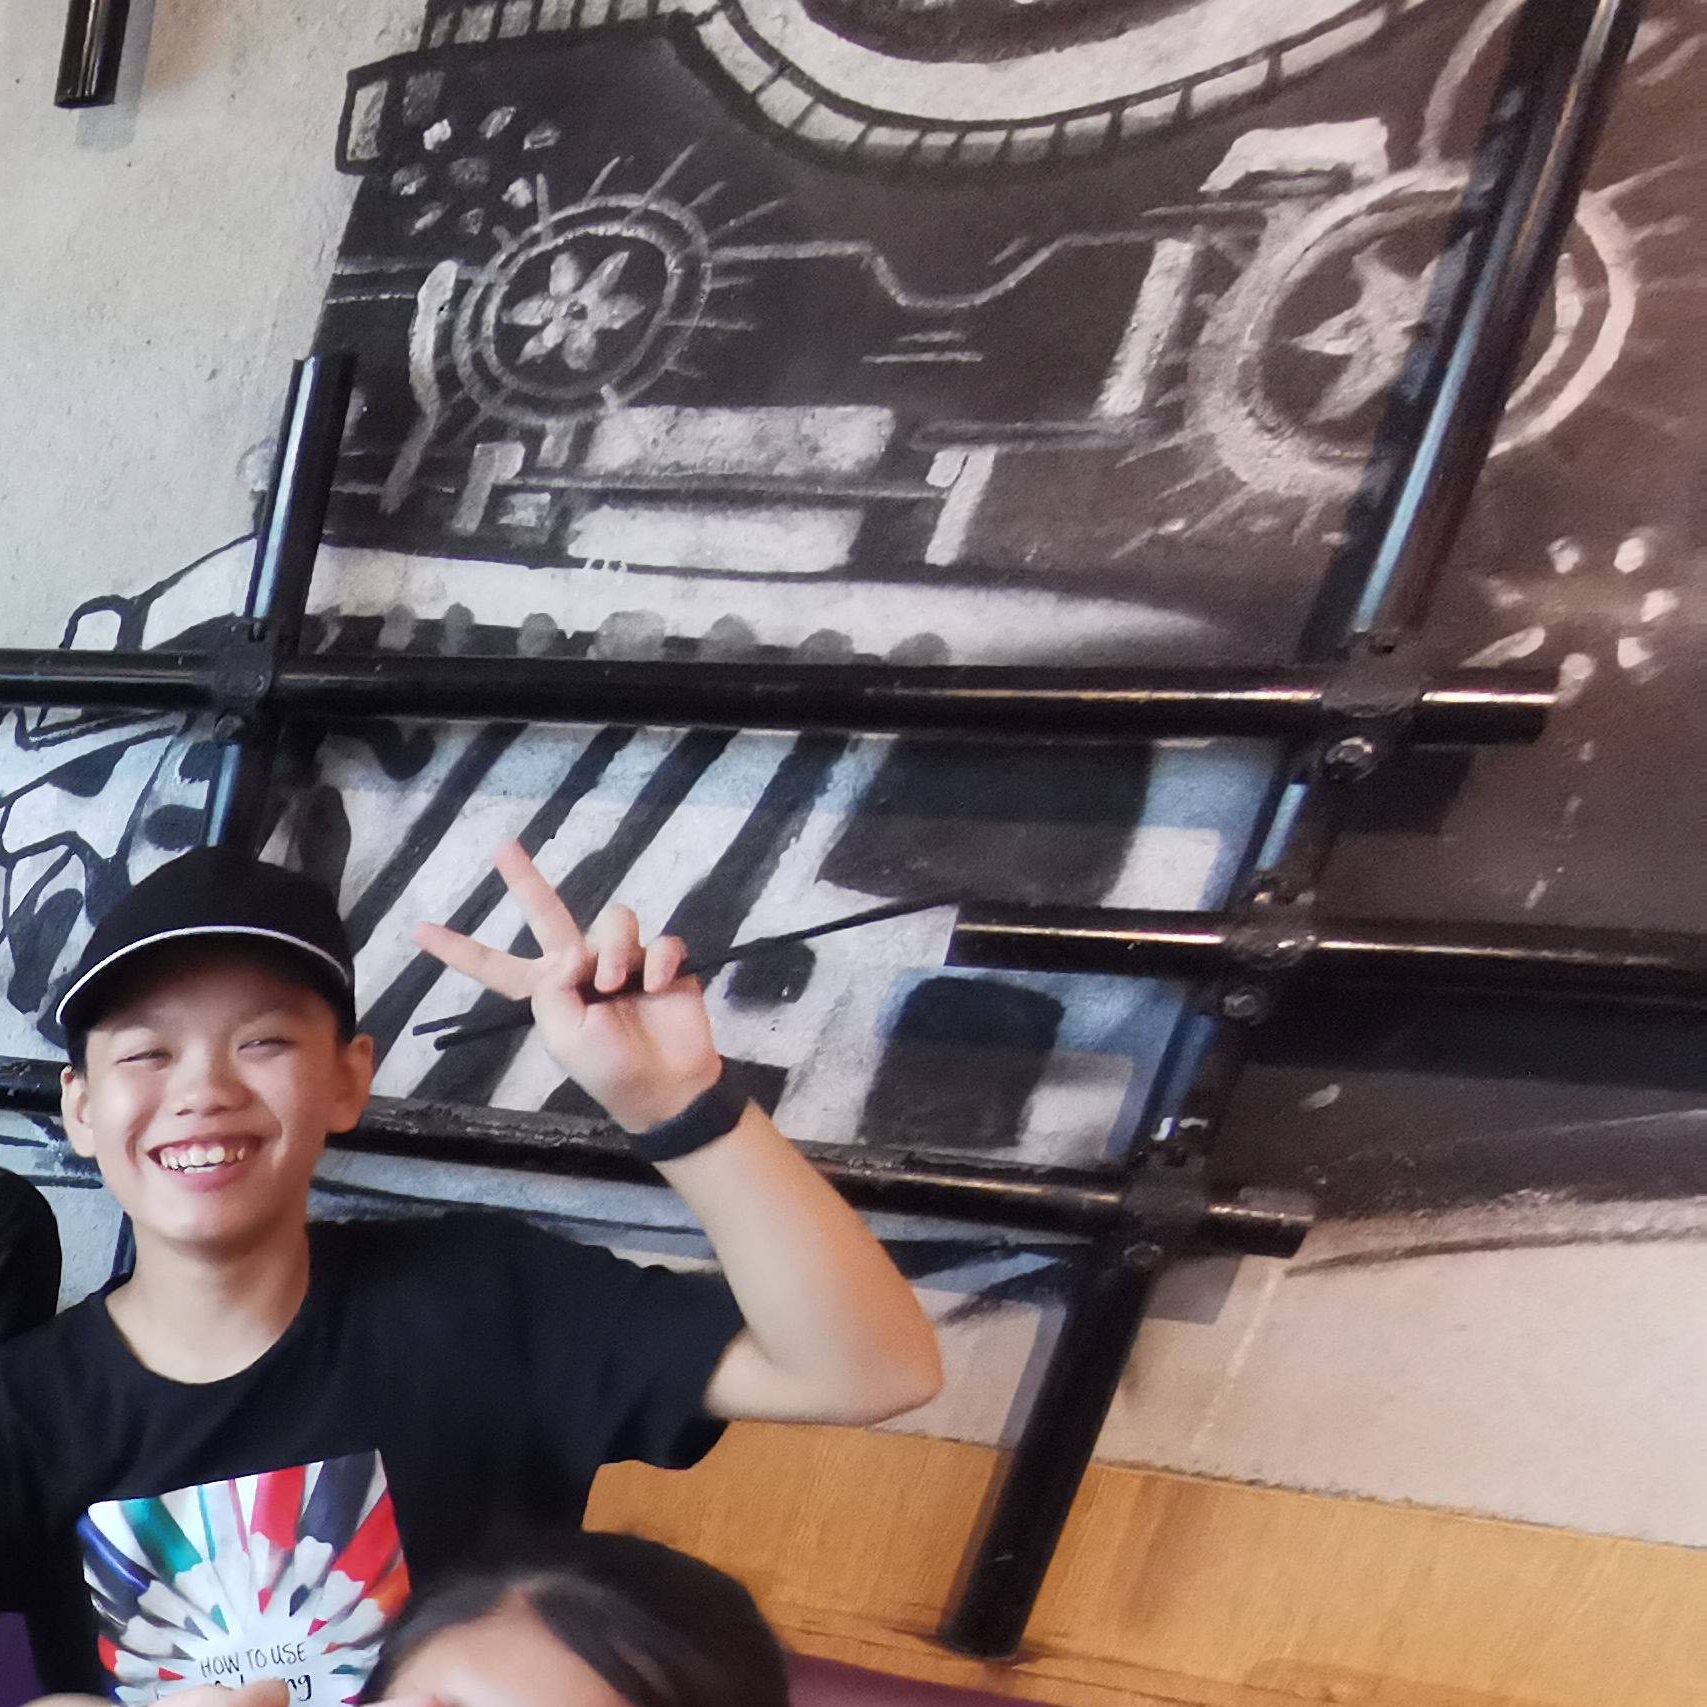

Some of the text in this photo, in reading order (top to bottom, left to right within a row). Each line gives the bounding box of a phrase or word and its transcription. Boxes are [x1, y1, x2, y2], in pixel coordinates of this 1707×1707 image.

[200, 1641, 307, 1678] HOW TO USE
